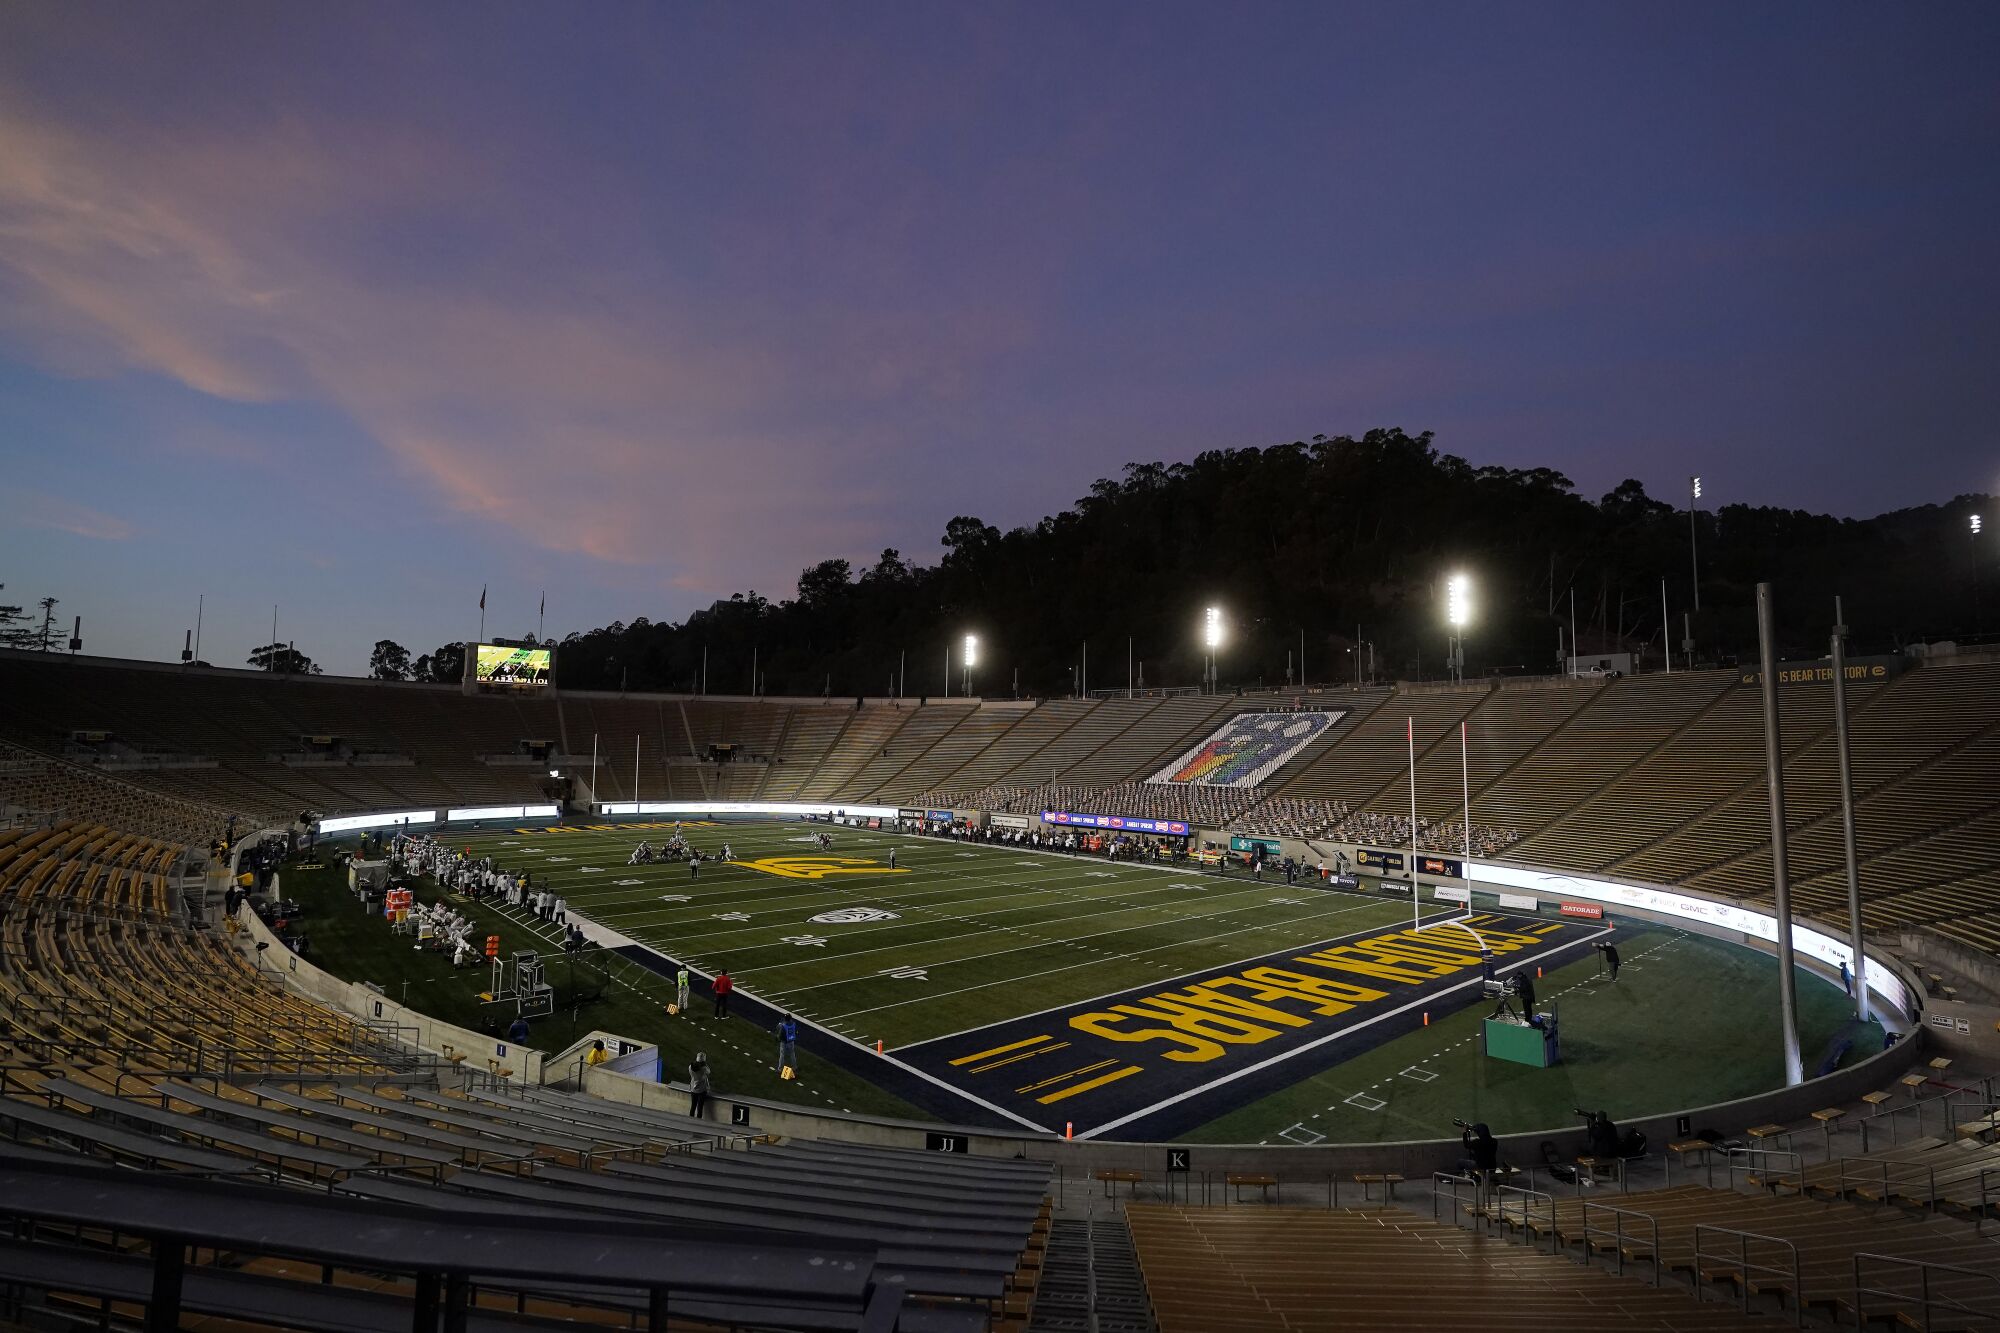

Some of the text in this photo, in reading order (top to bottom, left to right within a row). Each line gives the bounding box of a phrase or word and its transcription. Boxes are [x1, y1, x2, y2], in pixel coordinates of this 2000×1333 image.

[1779, 671, 1788, 683] IS
[1790, 670, 1813, 682] BEAR
[1815, 665, 1867, 681] TERTORY
[1339, 877, 1355, 885] TOYOTA
[1562, 904, 1600, 915] GATORADE
[1680, 903, 1709, 915] GMC
[878, 966, 928, 979] 10
[1069, 965, 1390, 1063] BEARS
[736, 1108, 744, 1122] J
[1680, 1119, 1689, 1133] L
[939, 1137, 954, 1152] JJ
[1171, 1152, 1185, 1168] K
